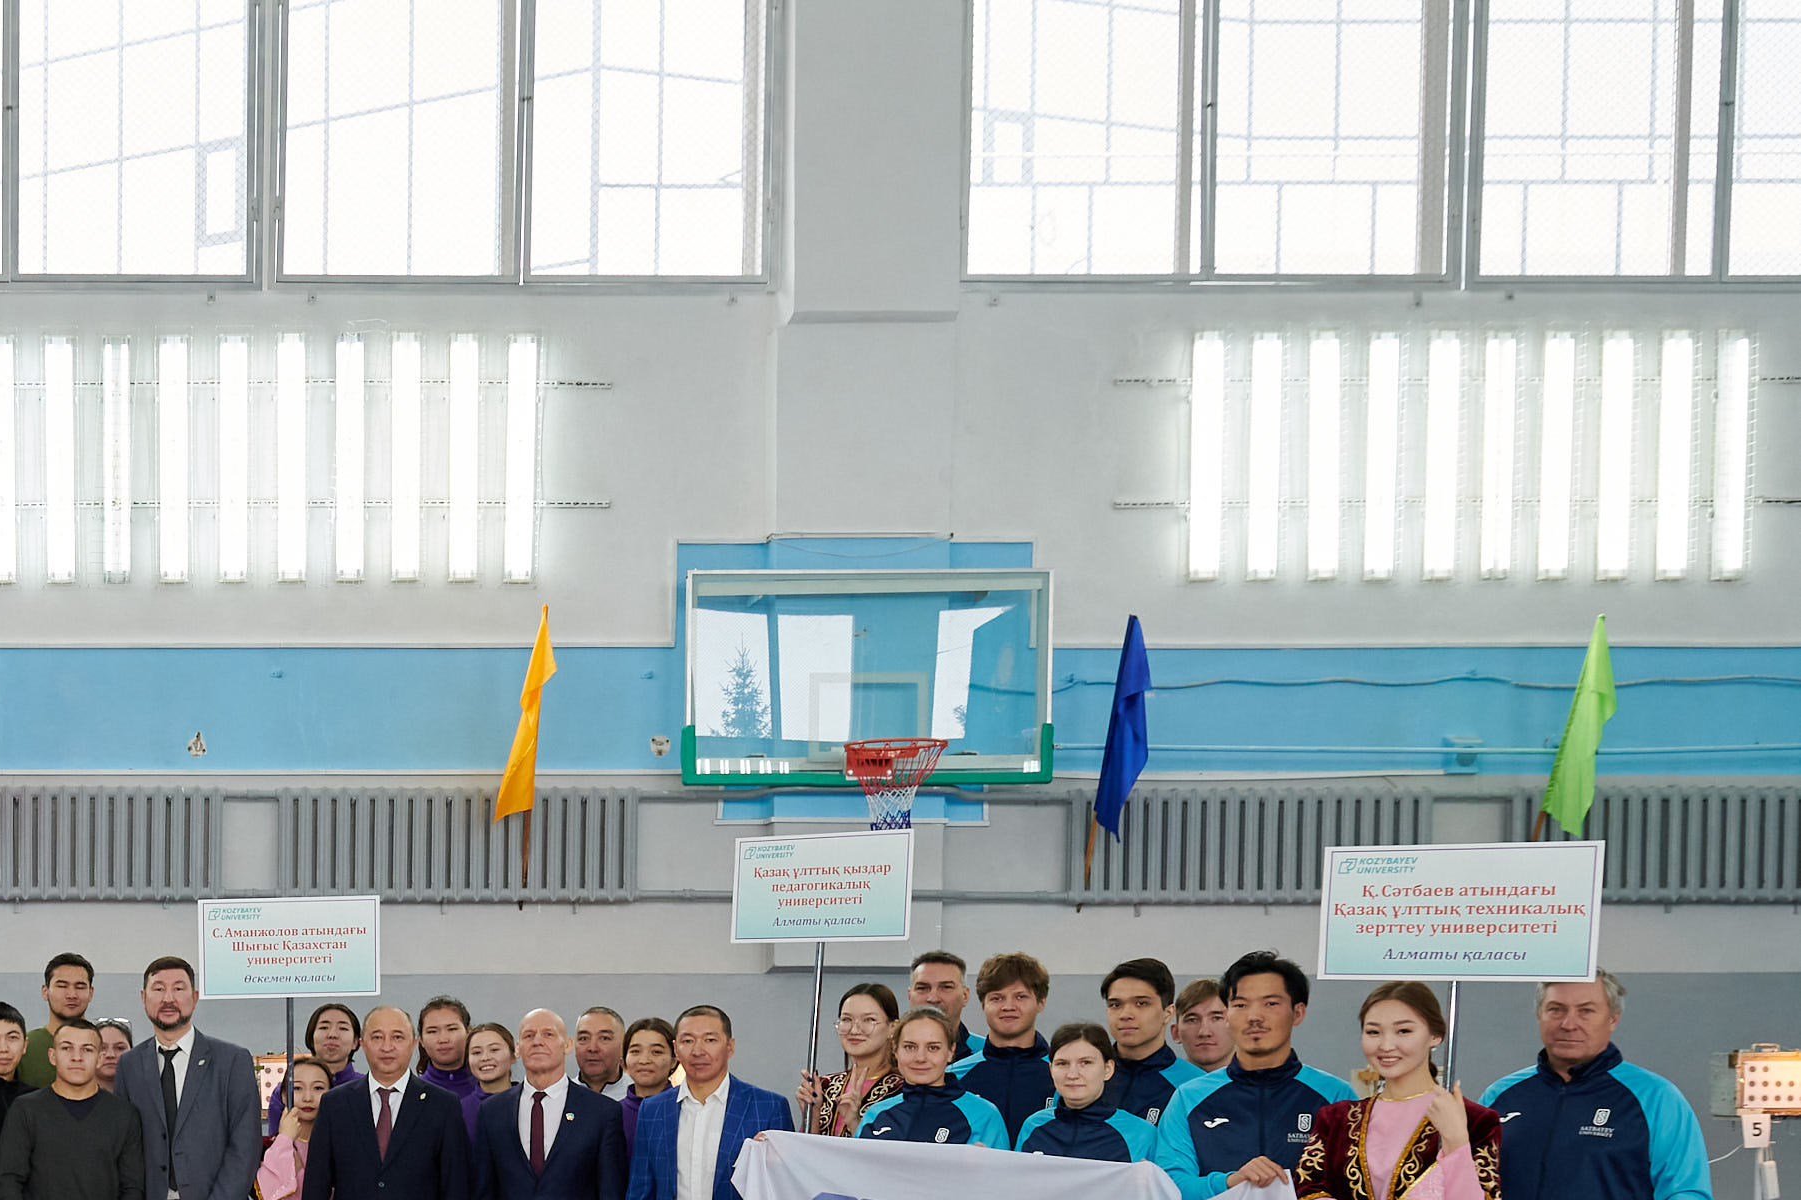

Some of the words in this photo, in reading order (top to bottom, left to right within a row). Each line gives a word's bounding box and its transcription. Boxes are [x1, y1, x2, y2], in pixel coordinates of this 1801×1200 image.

[1359, 857, 1418, 865] KOZYBAYEV
[753, 866, 790, 880] Қазақ
[843, 864, 892, 876] қыздар
[1357, 866, 1416, 874] UNIVERSITY
[771, 880, 872, 893] педагогикалық
[1459, 884, 1556, 898] атындағы
[777, 894, 863, 909] университеті
[1334, 903, 1387, 918] Қазақ
[1392, 903, 1461, 919] ұлттық
[1466, 902, 1586, 917] техникалық
[772, 917, 821, 927] Алматы
[824, 917, 866, 927] қаласы
[1355, 922, 1425, 937] зерттеу
[1431, 920, 1557, 937] университеті
[301, 926, 367, 937] атындағы
[232, 941, 280, 953] Шығыс
[246, 953, 332, 968] университеті
[1382, 948, 1459, 961] Алматы
[1462, 949, 1527, 963] қаласы
[243, 974, 292, 984] Өскемен
[294, 974, 336, 985] қаласы
[1752, 1122, 1763, 1137] 5
